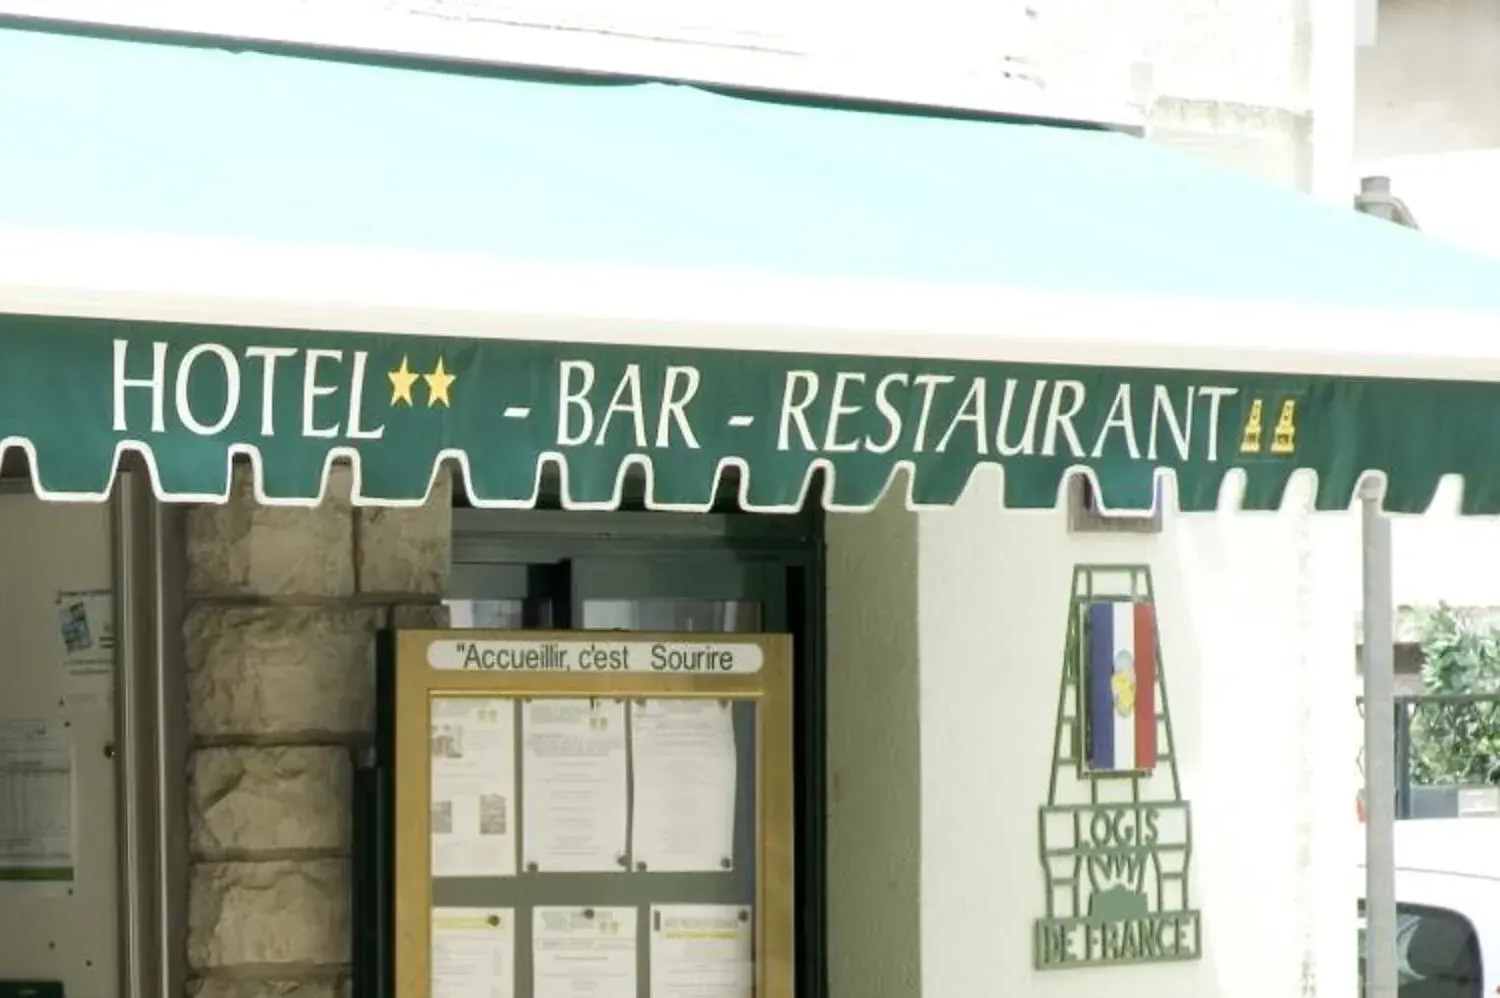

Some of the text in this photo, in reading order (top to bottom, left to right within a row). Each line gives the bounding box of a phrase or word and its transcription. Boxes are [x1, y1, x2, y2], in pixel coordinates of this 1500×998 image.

[111, 338, 385, 440] HOTEL
[556, 359, 701, 450] BAR
[776, 369, 1239, 462] RESTAURANT
[578, 645, 629, 671] c'est
[650, 644, 734, 671] Sourire
[1073, 805, 1160, 850] LOGIS
[1042, 912, 1193, 963] DE FRANCE
